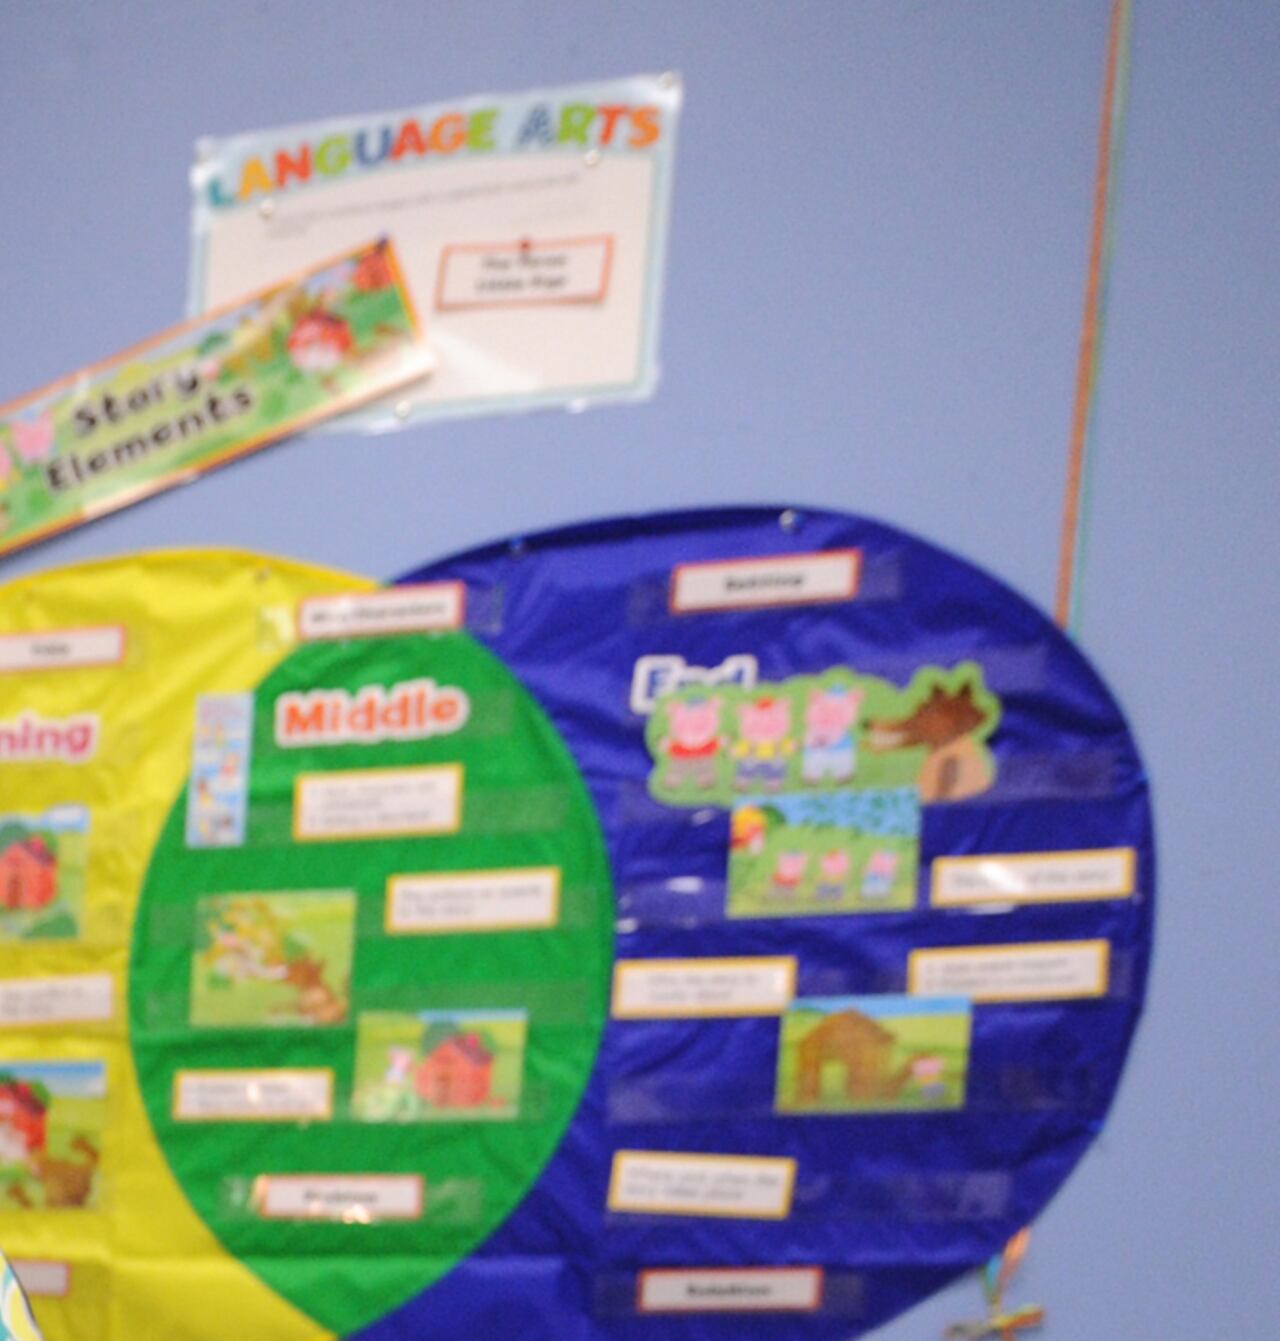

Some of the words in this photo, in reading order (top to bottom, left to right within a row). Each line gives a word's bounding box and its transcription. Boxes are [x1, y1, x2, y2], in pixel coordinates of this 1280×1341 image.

[206, 109, 501, 209] LANGUAGE
[518, 102, 663, 152] ARTS
[45, 388, 254, 493] Elements
[70, 366, 203, 437] Story
[280, 686, 464, 739] Middle
